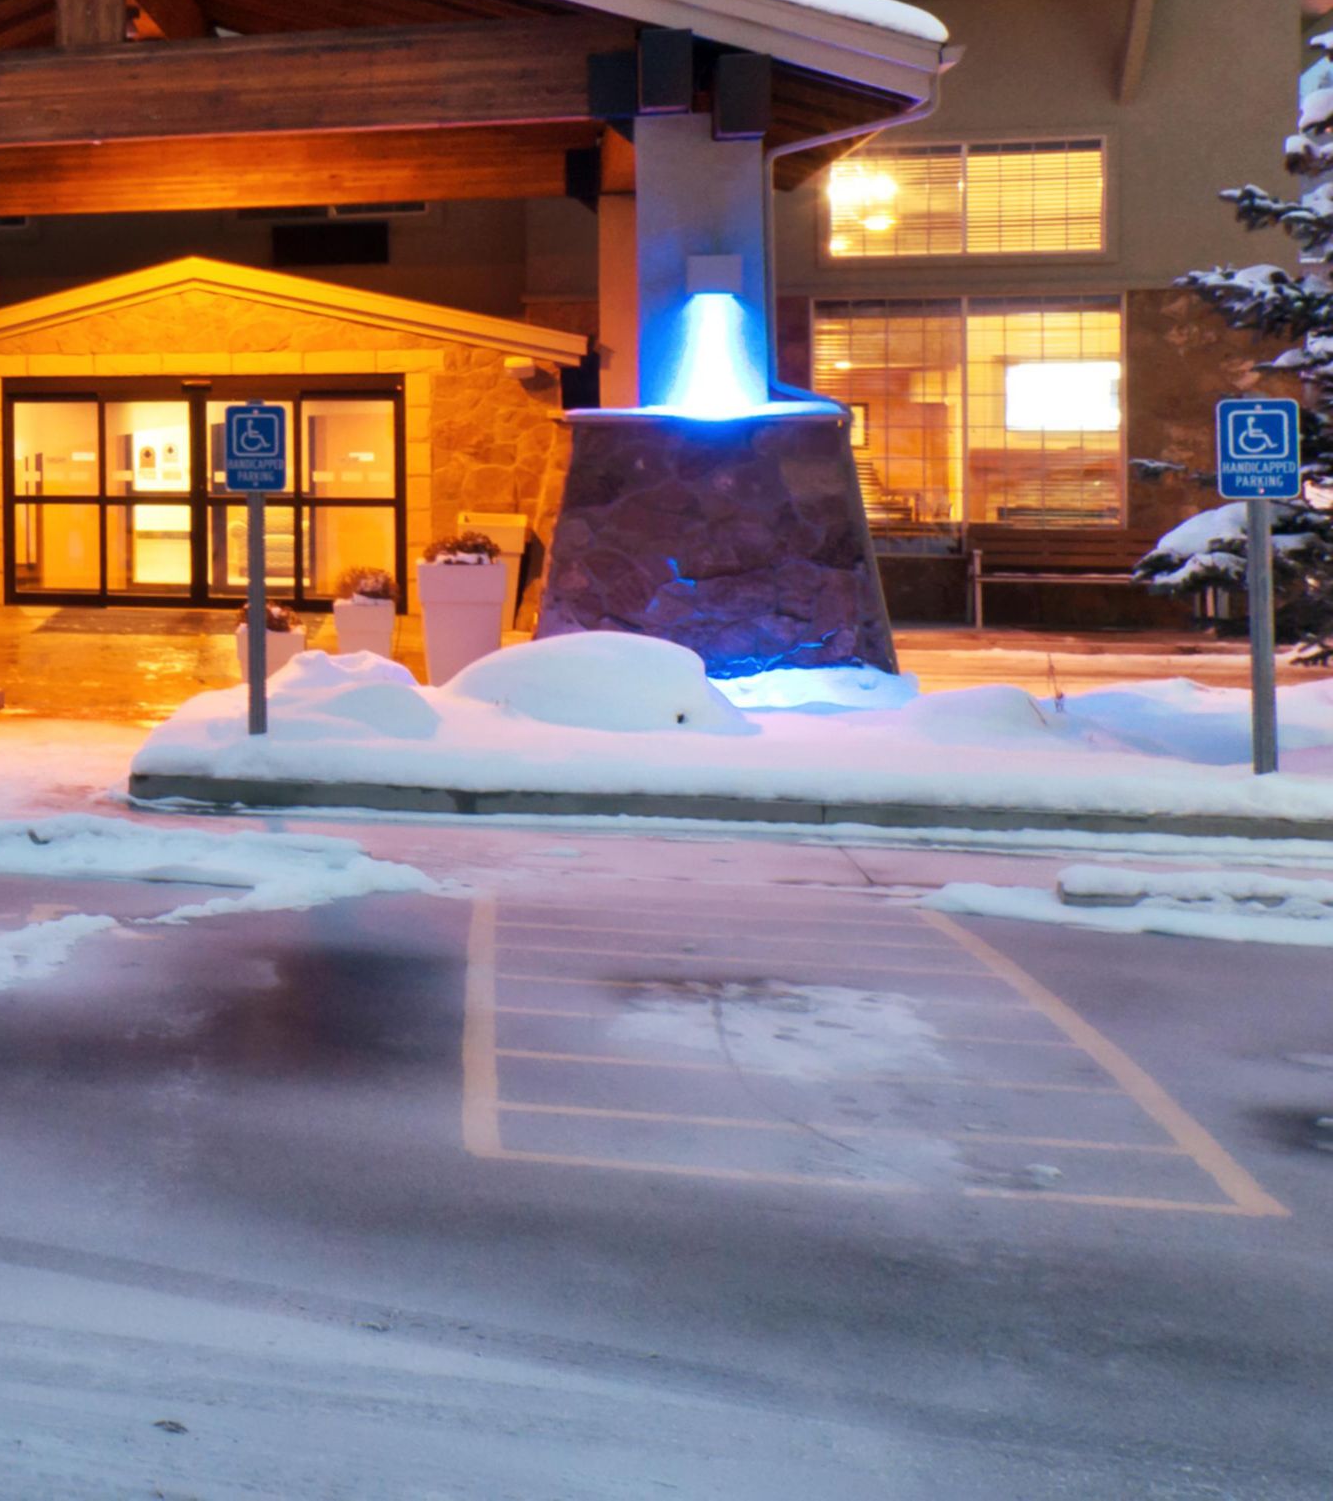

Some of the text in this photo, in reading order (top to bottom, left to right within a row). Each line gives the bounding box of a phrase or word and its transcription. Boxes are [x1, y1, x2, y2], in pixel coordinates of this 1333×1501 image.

[228, 459, 284, 470] HANDICAPPED
[1222, 462, 1296, 475] HANDICAPPED
[237, 471, 275, 482] PARKING
[1235, 475, 1284, 488] PARKING
